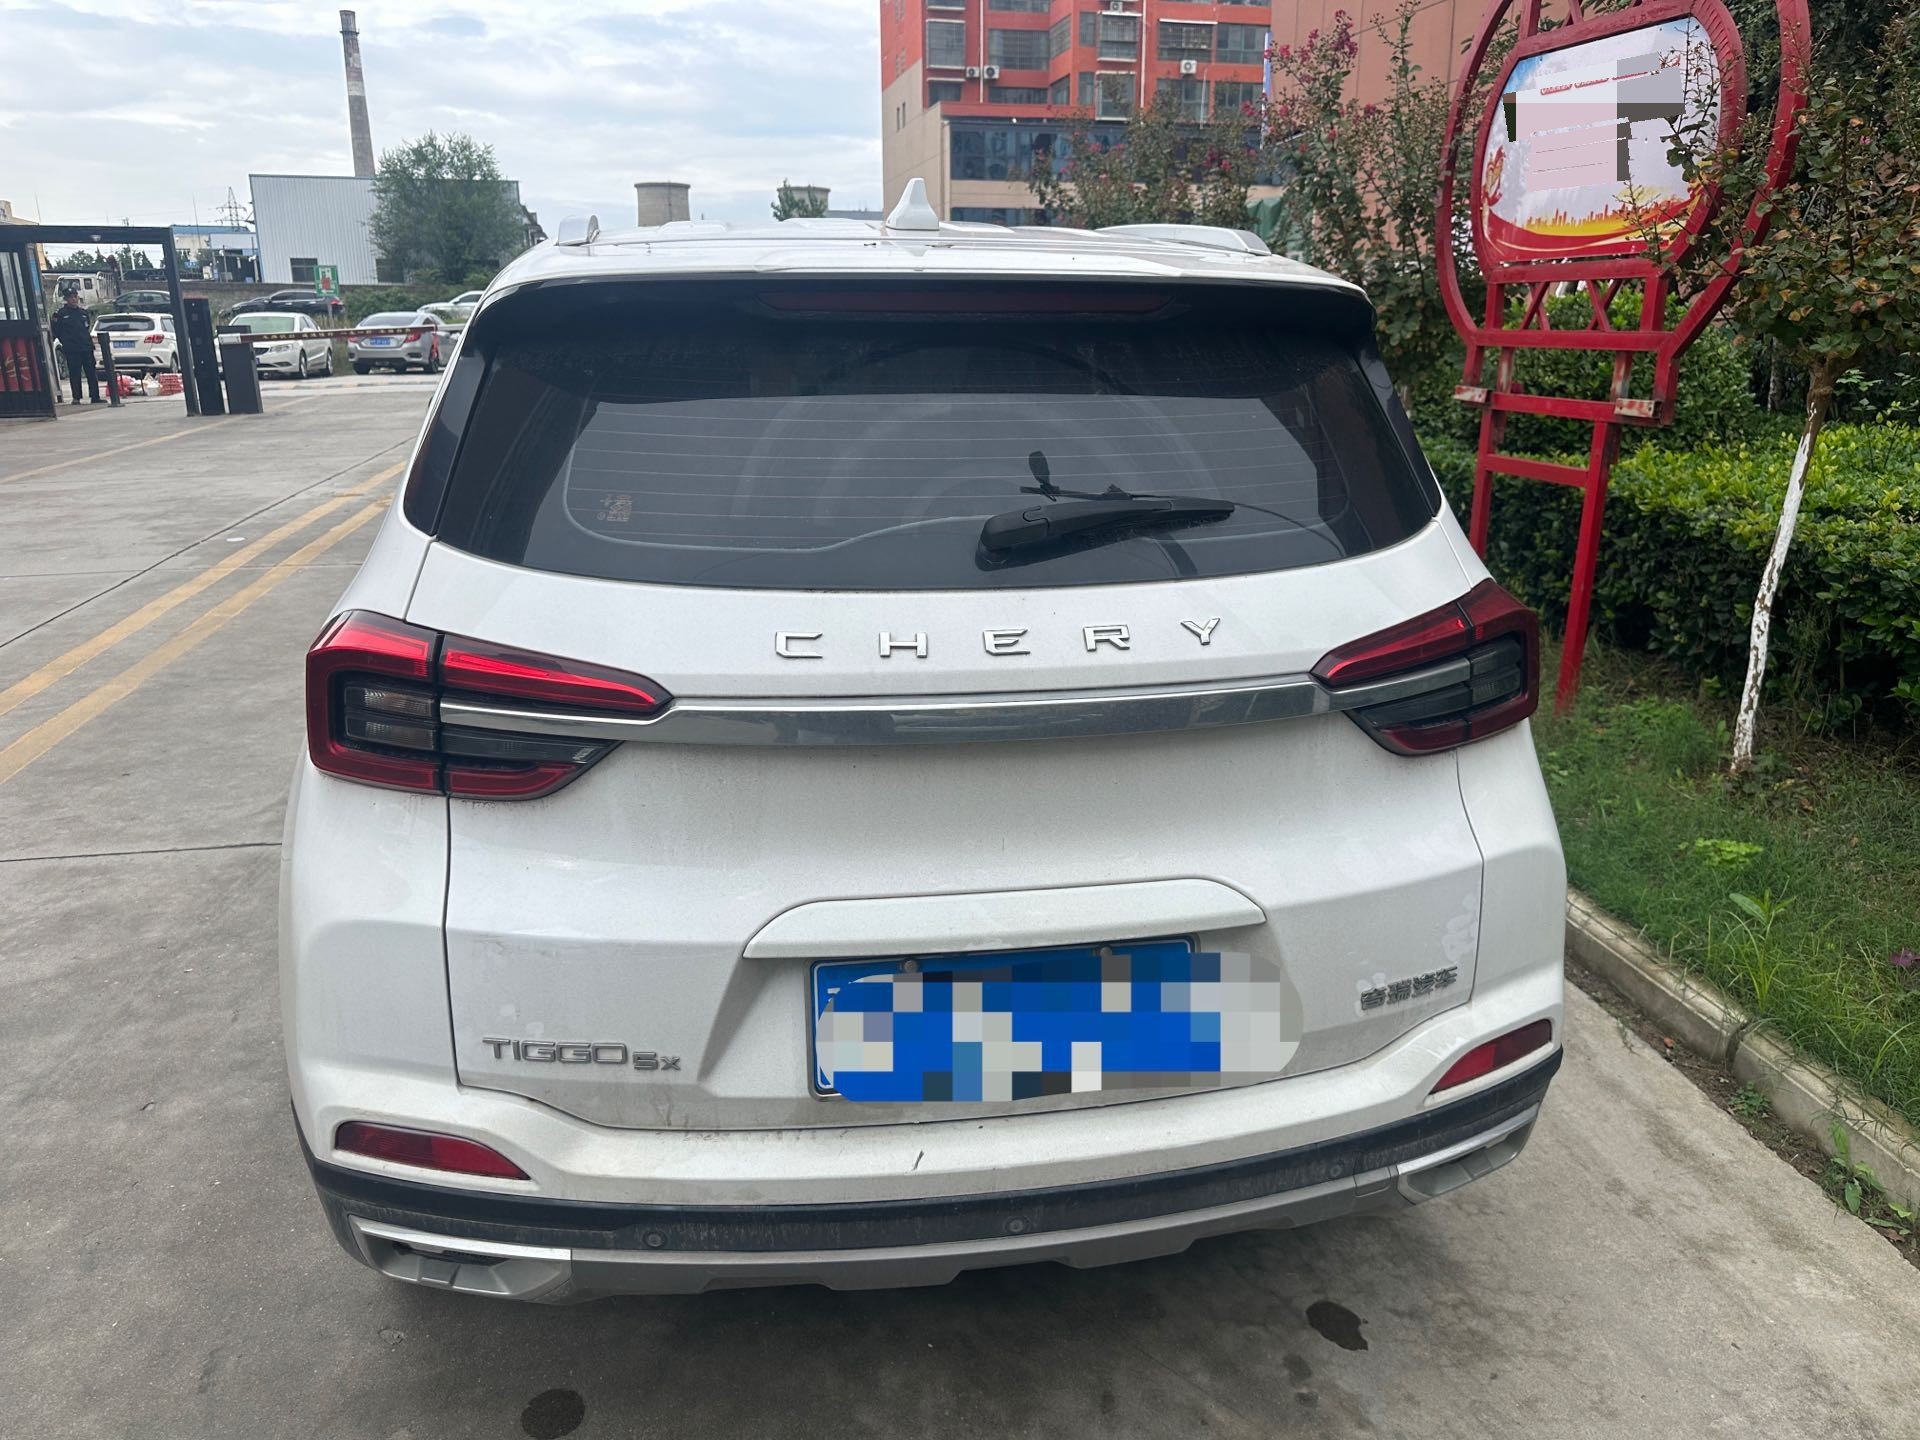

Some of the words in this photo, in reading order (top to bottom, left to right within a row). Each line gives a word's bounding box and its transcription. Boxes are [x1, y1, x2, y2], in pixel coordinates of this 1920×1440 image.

[774, 617, 1221, 659] CHERY
[1360, 965, 1458, 1011] 奇瑞汽车
